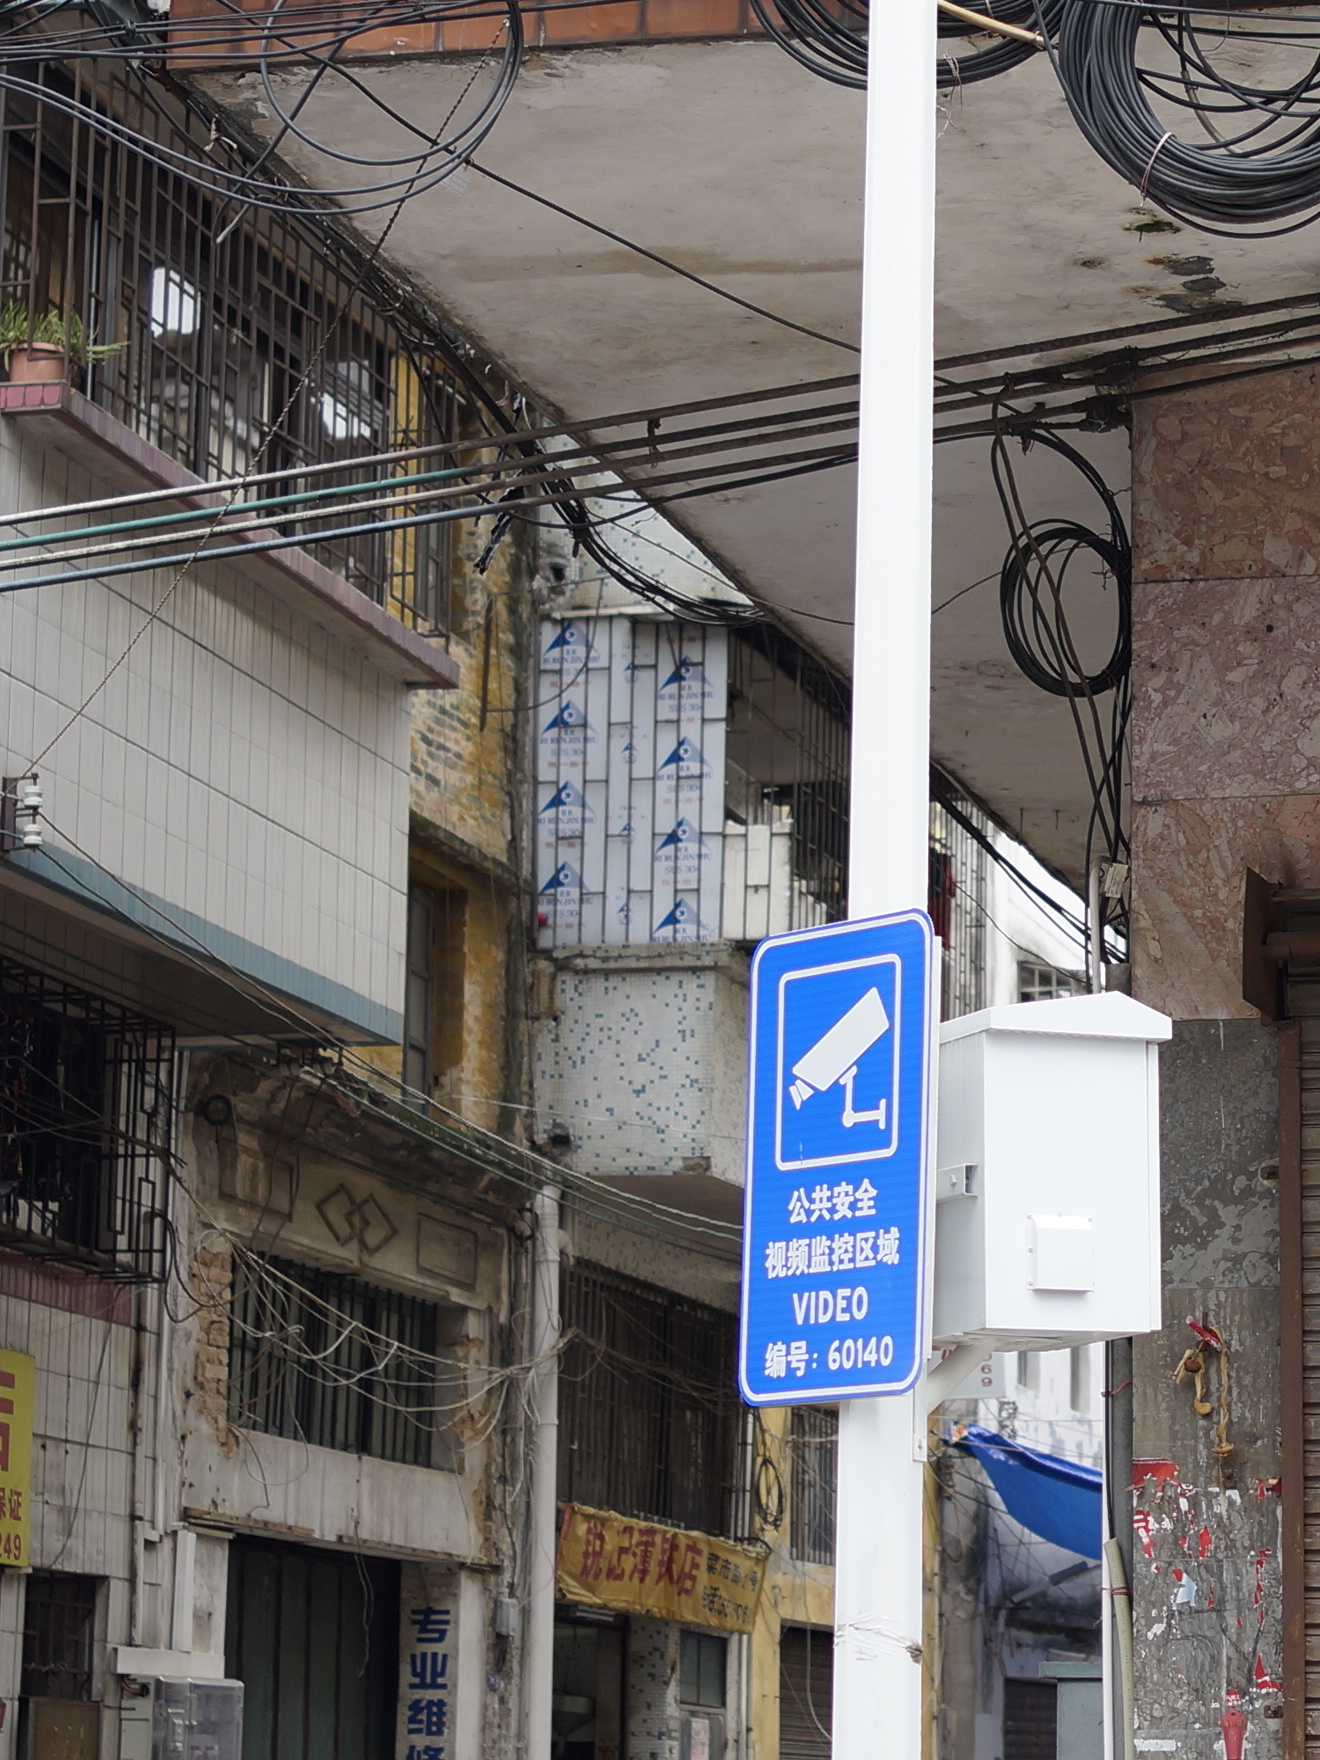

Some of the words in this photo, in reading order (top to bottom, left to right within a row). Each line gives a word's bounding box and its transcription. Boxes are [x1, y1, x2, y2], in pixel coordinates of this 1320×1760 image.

[788, 1178, 878, 1224] 公共安全
[765, 1226, 900, 1279] 视频监控区域
[792, 1286, 869, 1325] VIDEO
